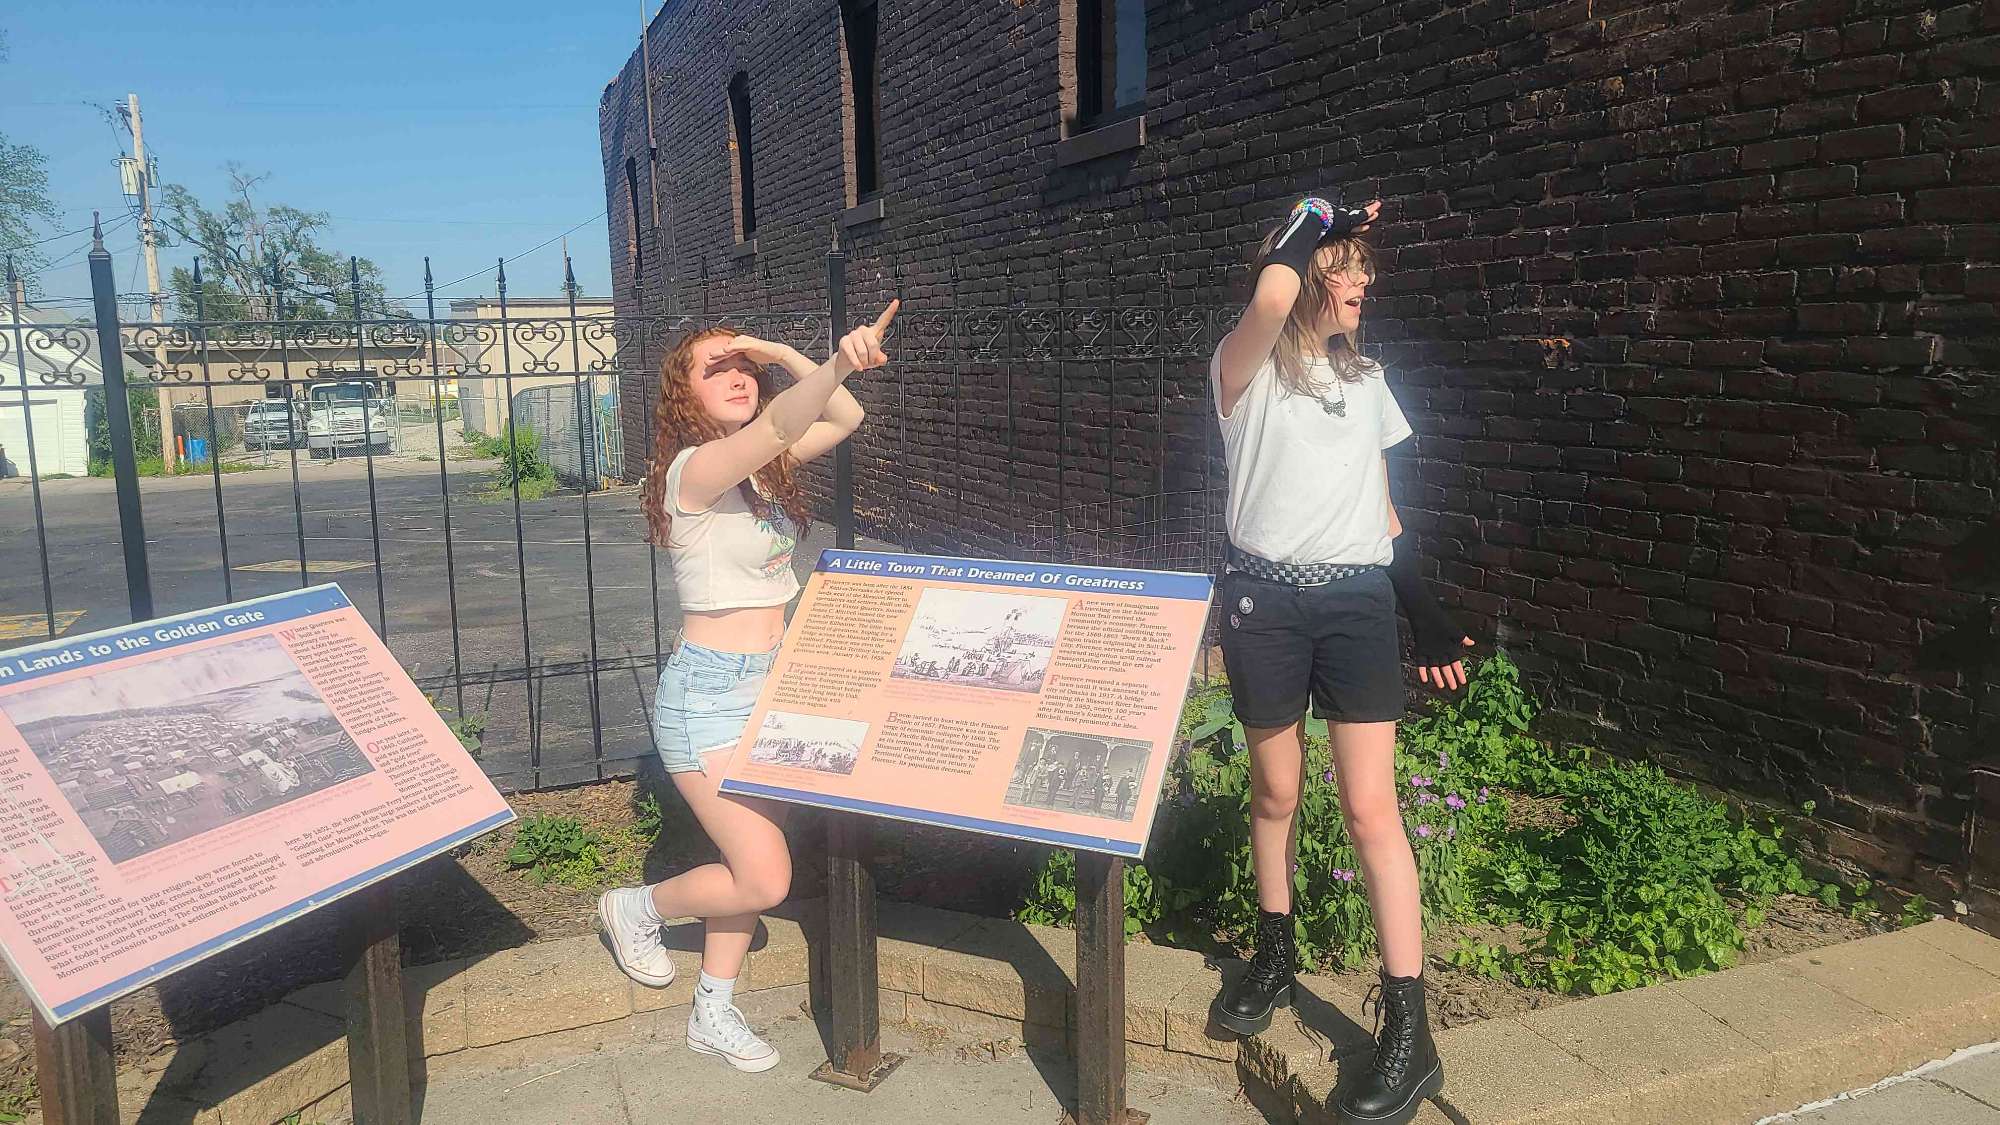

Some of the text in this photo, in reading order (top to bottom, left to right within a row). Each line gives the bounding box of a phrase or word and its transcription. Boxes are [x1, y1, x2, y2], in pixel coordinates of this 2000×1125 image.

[829, 559, 1144, 590] A Little Town That Dreamed Of Greatness
[18, 612, 264, 672] Lands to the Golden Gate
[32, 926, 79, 945] Mormons.
[78, 905, 126, 927] Persecuted
[141, 892, 160, 903] their
[162, 881, 195, 894] religion,
[195, 872, 211, 881] they
[212, 865, 231, 874] were
[231, 855, 255, 867] forced
[38, 942, 62, 954] leave
[63, 929, 95, 943] Illinois
[106, 909, 143, 927] February
[144, 900, 168, 911] 1846,
[169, 885, 203, 901] crossing
[202, 878, 216, 888] the
[217, 871, 240, 883] frozen
[240, 853, 281, 873] Mississippi
[44, 950, 71, 962] River.
[72, 940, 93, 951] Four
[95, 927, 127, 942] months
[128, 918, 147, 928] later
[149, 910, 167, 919] they
[168, 897, 198, 912] arrived,
[198, 878, 243, 899] discouraged
[244, 870, 258, 881] and
[258, 863, 278, 875] tired,
[51, 958, 74, 970] what
[75, 948, 98, 961] today
[111, 932, 136, 946] called
[136, 918, 174, 935] Florence.
[175, 910, 190, 919] The
[192, 899, 219, 912] Omaha
[219, 887, 247, 901] Indians
[248, 880, 264, 890] gave
[56, 959, 99, 979] Mormons
[100, 939, 147, 963] permission
[158, 924, 180, 936] build
[188, 905, 228, 924] settlement
[239, 892, 258, 902] their
[257, 884, 277, 895] land.
